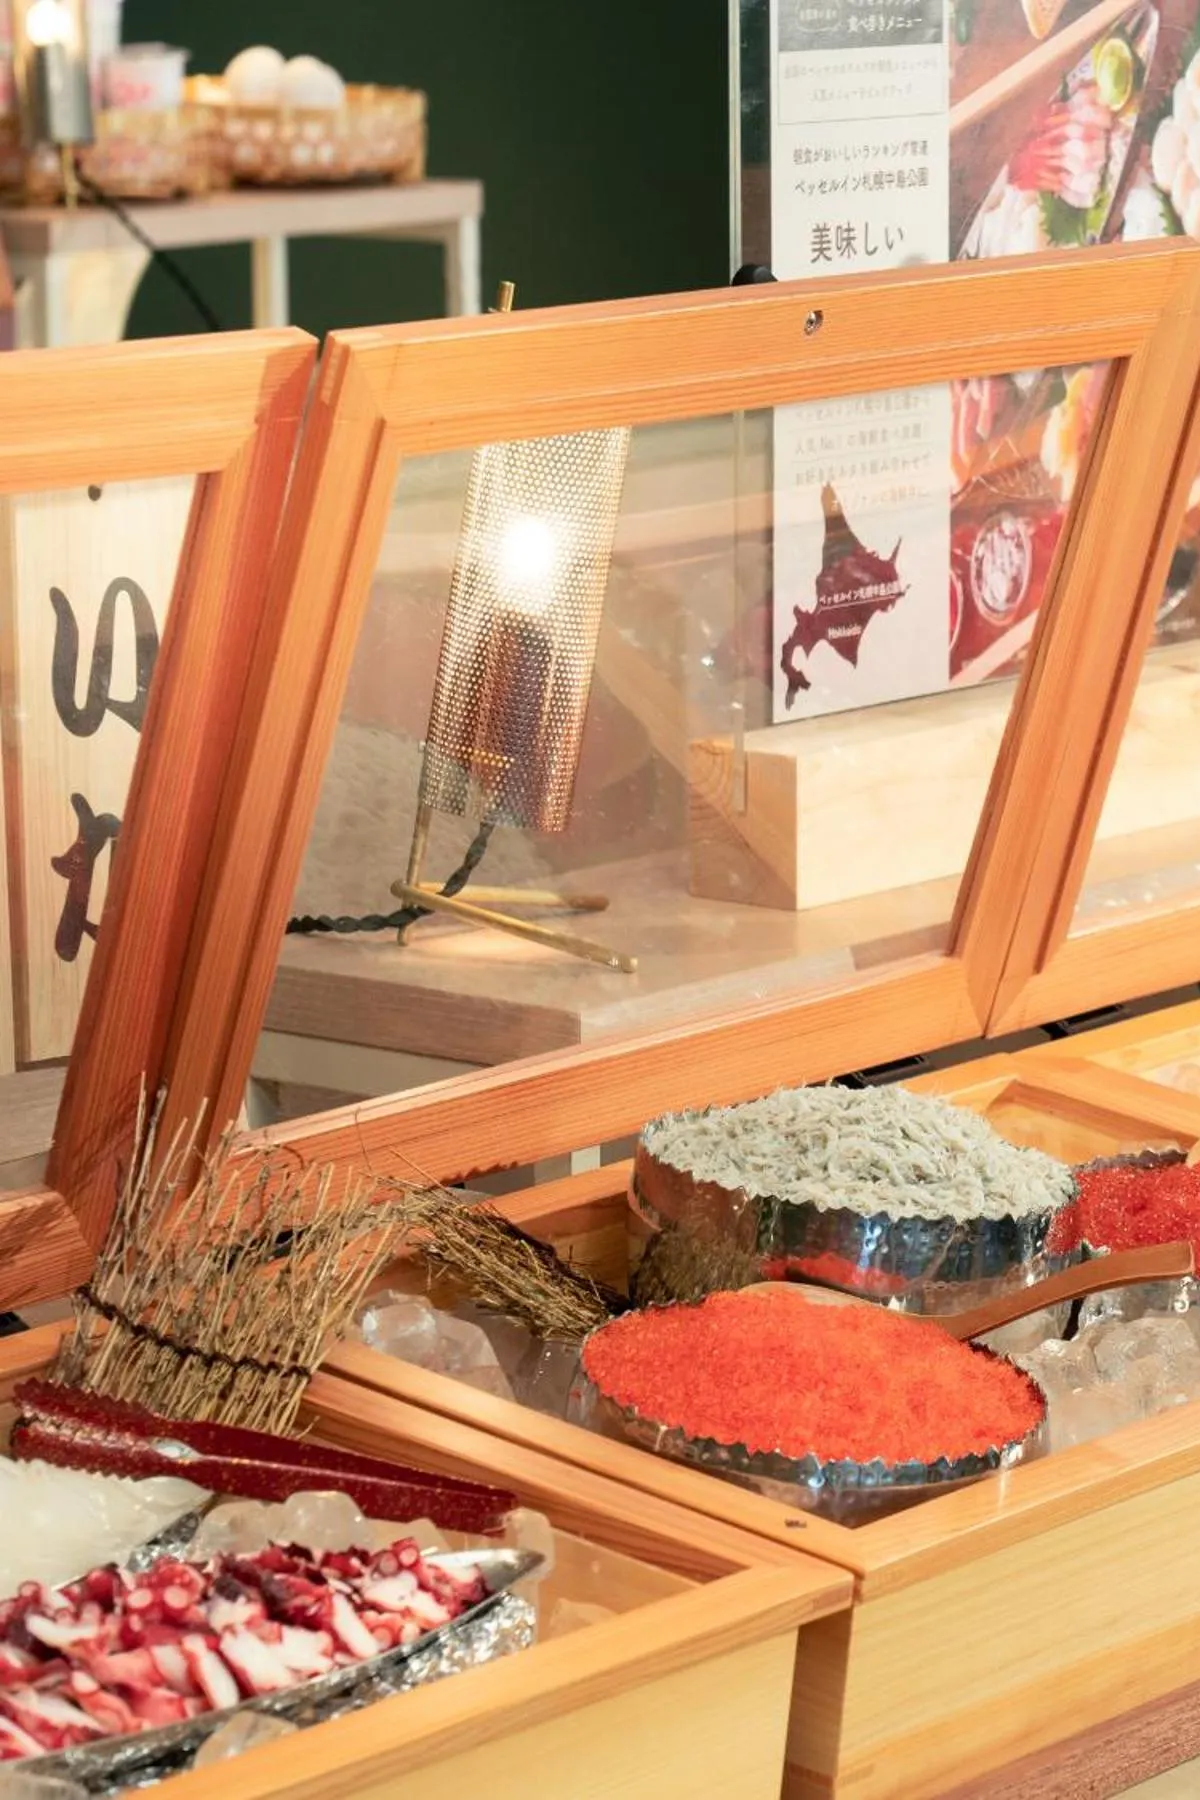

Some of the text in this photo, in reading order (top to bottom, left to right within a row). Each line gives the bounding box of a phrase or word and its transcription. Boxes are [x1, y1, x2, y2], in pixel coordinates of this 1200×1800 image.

[795, 167, 929, 195] ベッセルイン札幌中島公園
[811, 221, 904, 264] 美味しい
